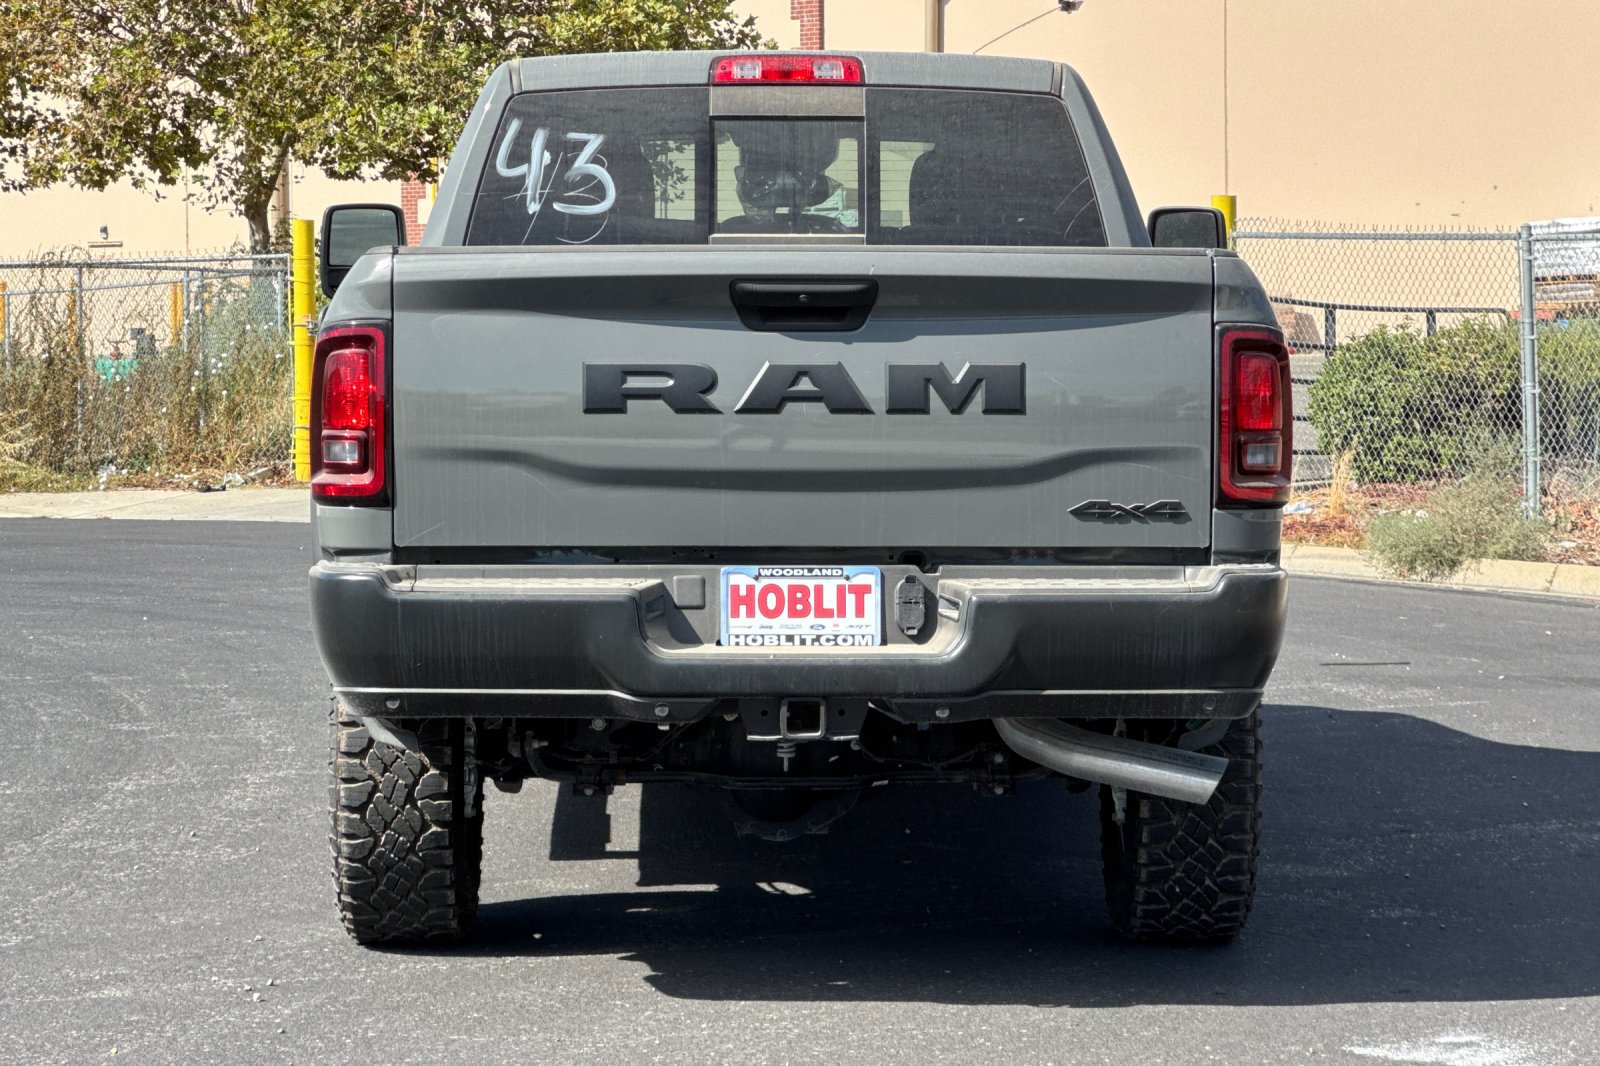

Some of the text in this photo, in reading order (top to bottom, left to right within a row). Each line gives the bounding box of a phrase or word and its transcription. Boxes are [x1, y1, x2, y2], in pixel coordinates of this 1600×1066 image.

[582, 361, 1027, 415] RAM
[759, 568, 843, 577] WOODLAND
[730, 583, 872, 619] HOBLIT
[729, 634, 873, 646] HOBLIT.COM
